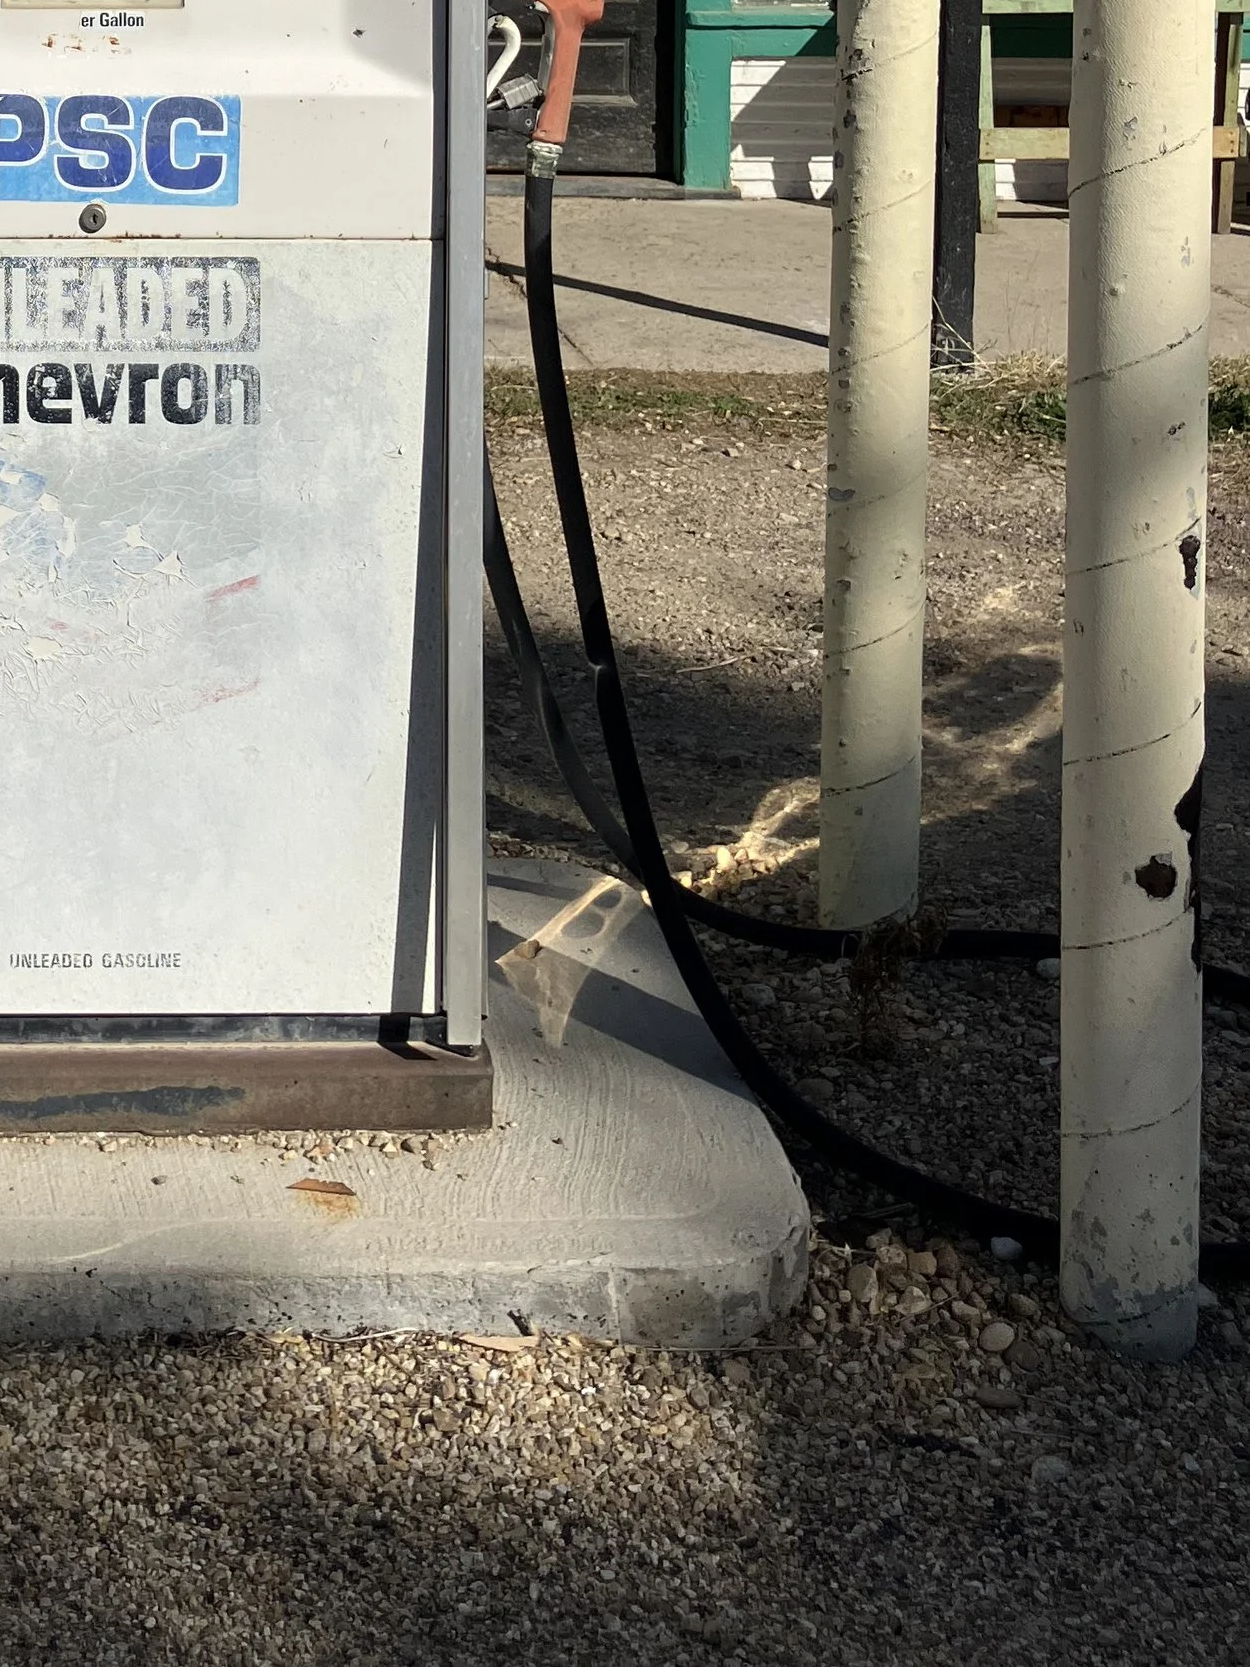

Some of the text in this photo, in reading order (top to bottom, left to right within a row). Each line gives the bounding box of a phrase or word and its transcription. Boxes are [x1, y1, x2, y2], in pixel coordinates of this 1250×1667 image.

[81, 12, 144, 27] er Gallon
[9, 953, 182, 968] UNLEADED GASOLINE
